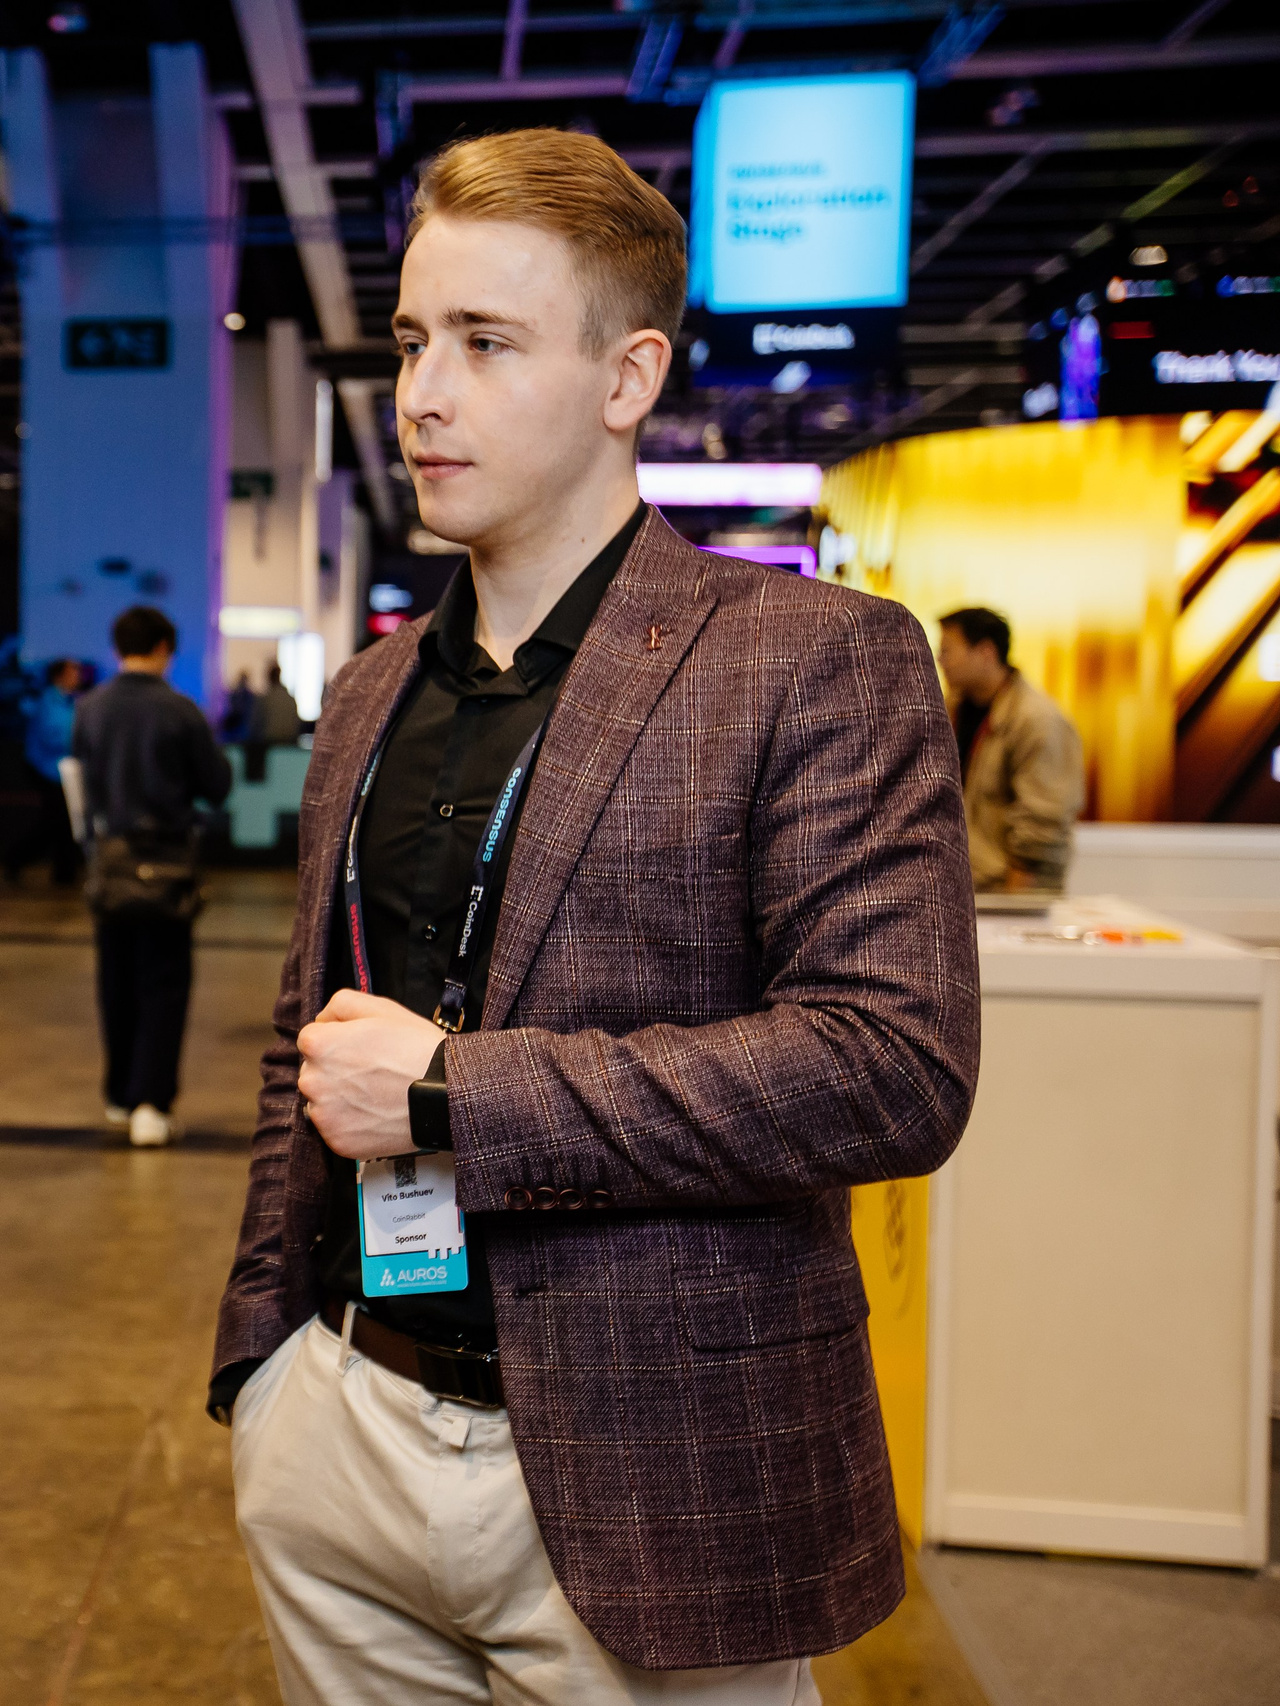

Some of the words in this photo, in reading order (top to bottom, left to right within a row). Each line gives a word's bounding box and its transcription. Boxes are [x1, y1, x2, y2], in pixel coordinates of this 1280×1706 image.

[457, 900, 478, 958] CoinDesk
[381, 1193, 398, 1202] Vito
[399, 1188, 434, 1200] Bushuev
[392, 1213, 426, 1224] CoinRabbit
[394, 1233, 427, 1245] Sponsor
[397, 1266, 448, 1282] AUROS
